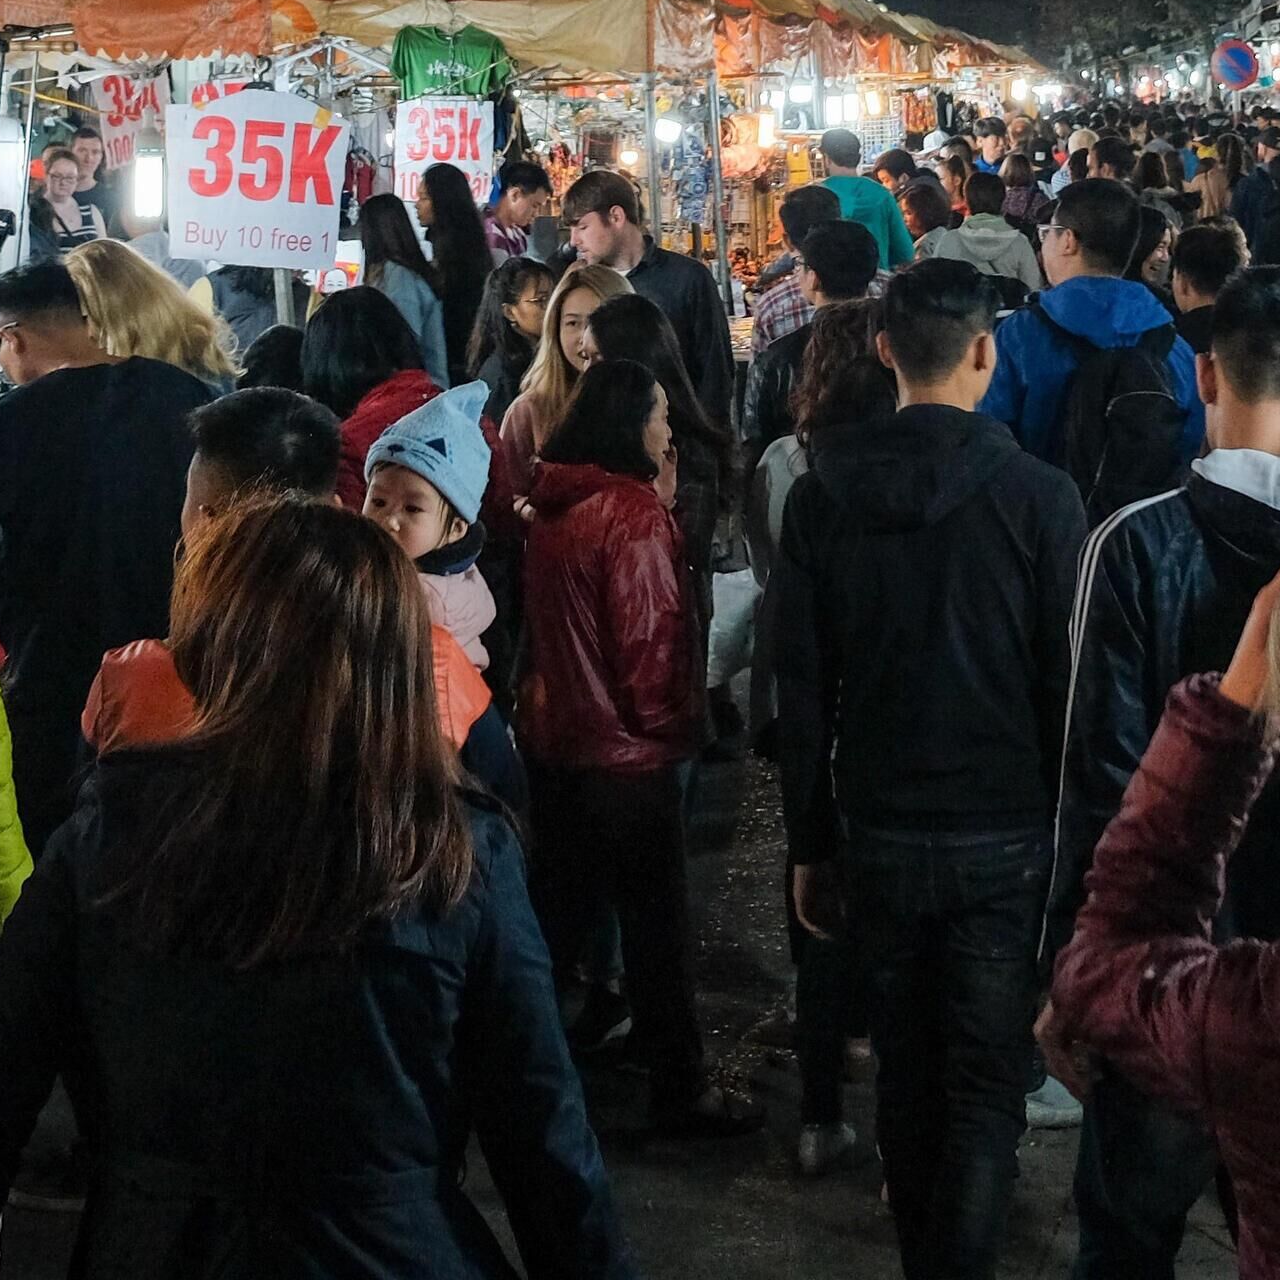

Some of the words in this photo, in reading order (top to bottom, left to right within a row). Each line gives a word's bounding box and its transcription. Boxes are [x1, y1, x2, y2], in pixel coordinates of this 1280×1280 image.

[188, 115, 343, 205] 35K
[185, 221, 227, 251] Buy
[238, 226, 263, 248] 10
[271, 228, 312, 252] free
[322, 231, 330, 252] 1
